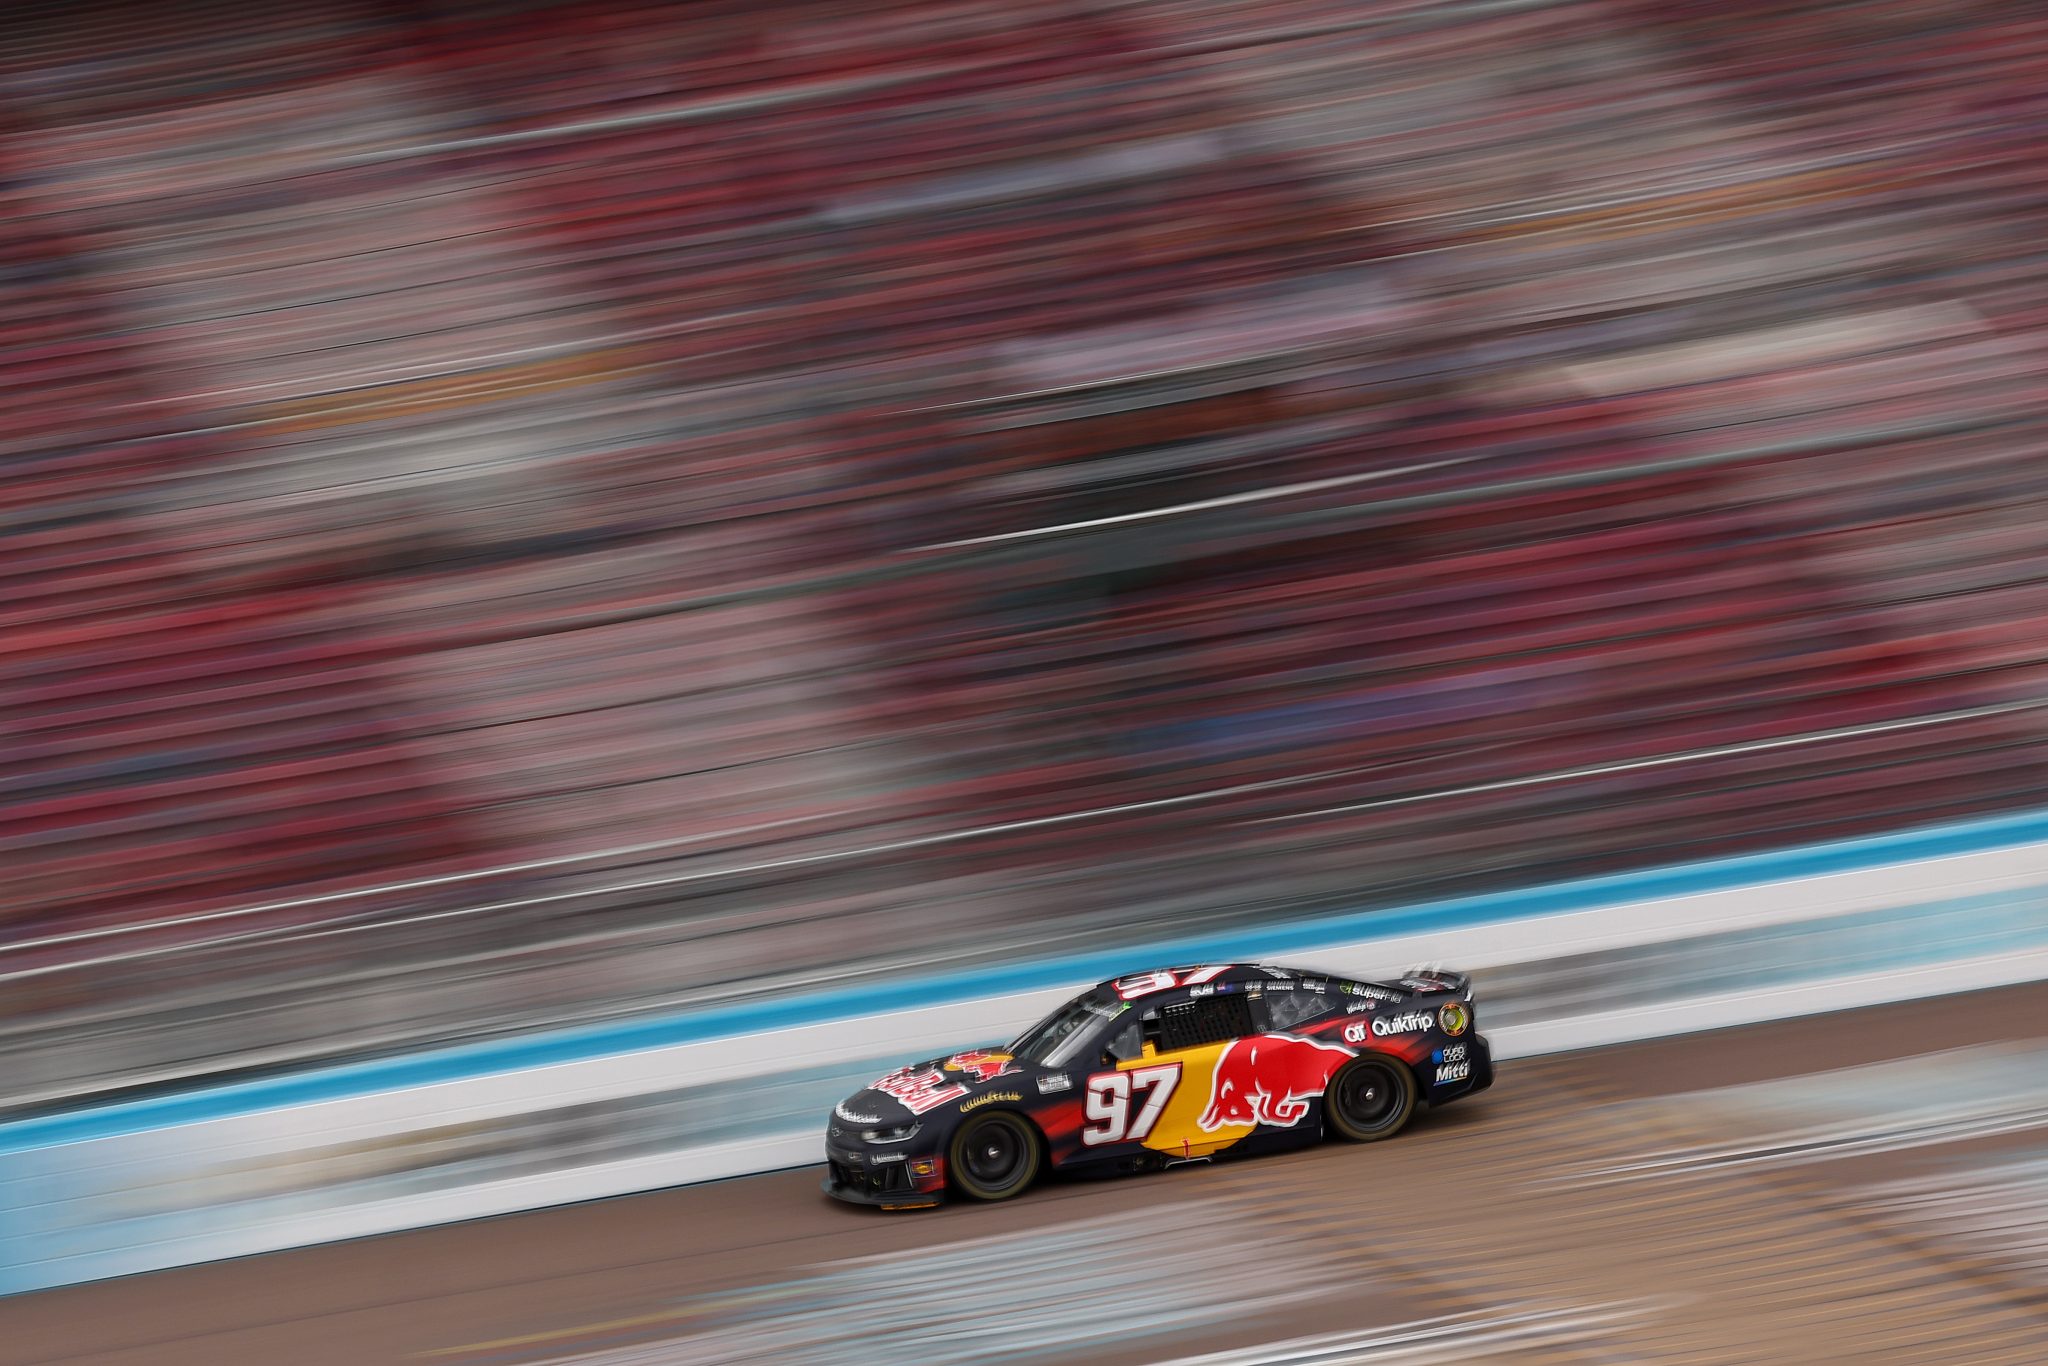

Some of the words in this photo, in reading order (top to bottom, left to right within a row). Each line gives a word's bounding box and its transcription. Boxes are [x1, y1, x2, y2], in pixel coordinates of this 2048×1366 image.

[1265, 982, 1295, 991] SIEMENS
[1344, 1021, 1366, 1042] QT
[1371, 1010, 1433, 1036] QuikTrip
[1443, 1053, 1465, 1063] LOCK
[1435, 1062, 1469, 1082] Mitti
[1081, 1063, 1182, 1147] 97
